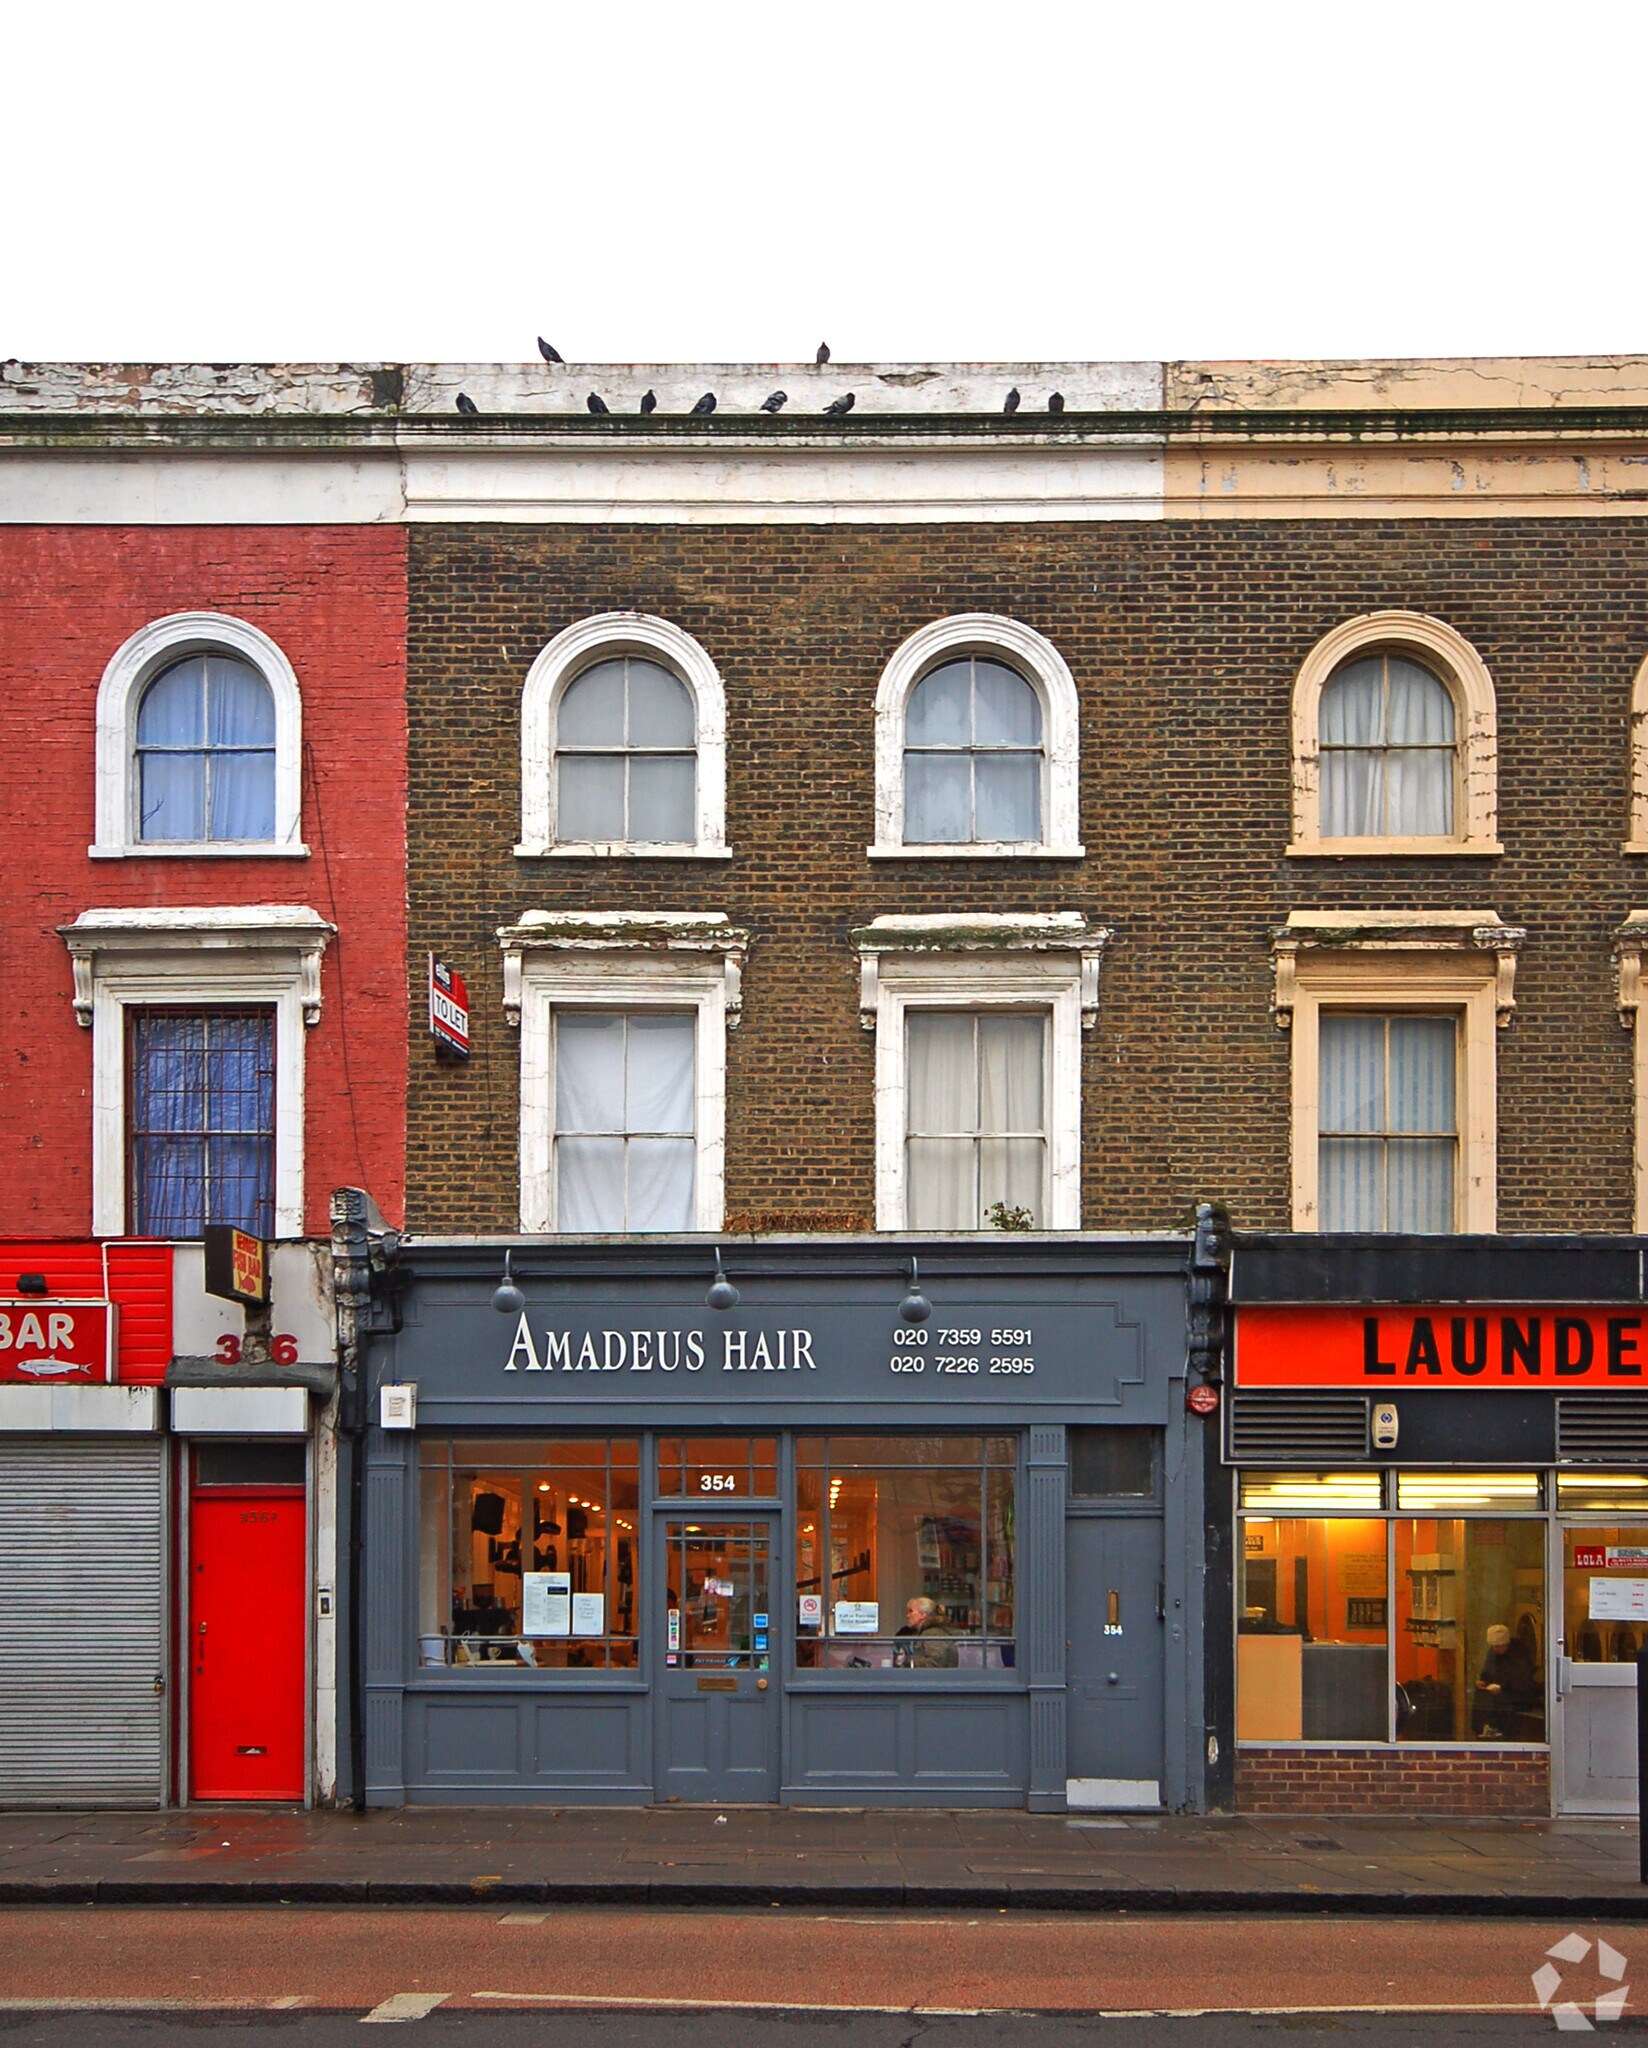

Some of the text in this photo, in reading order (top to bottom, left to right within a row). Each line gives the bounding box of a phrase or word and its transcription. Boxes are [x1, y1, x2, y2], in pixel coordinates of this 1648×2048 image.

[436, 994, 466, 1032] TO LET
[0, 1312, 75, 1350] BAR
[893, 1329, 1032, 1345] 020 7359 5591
[722, 1329, 817, 1370] HAIR
[1363, 1316, 1643, 1376] LAUNDE
[890, 1356, 1035, 1374] 020 7226 2595
[700, 1474, 736, 1491] 354
[1576, 1554, 1604, 1566] LOLA
[1103, 1624, 1122, 1635] 354
